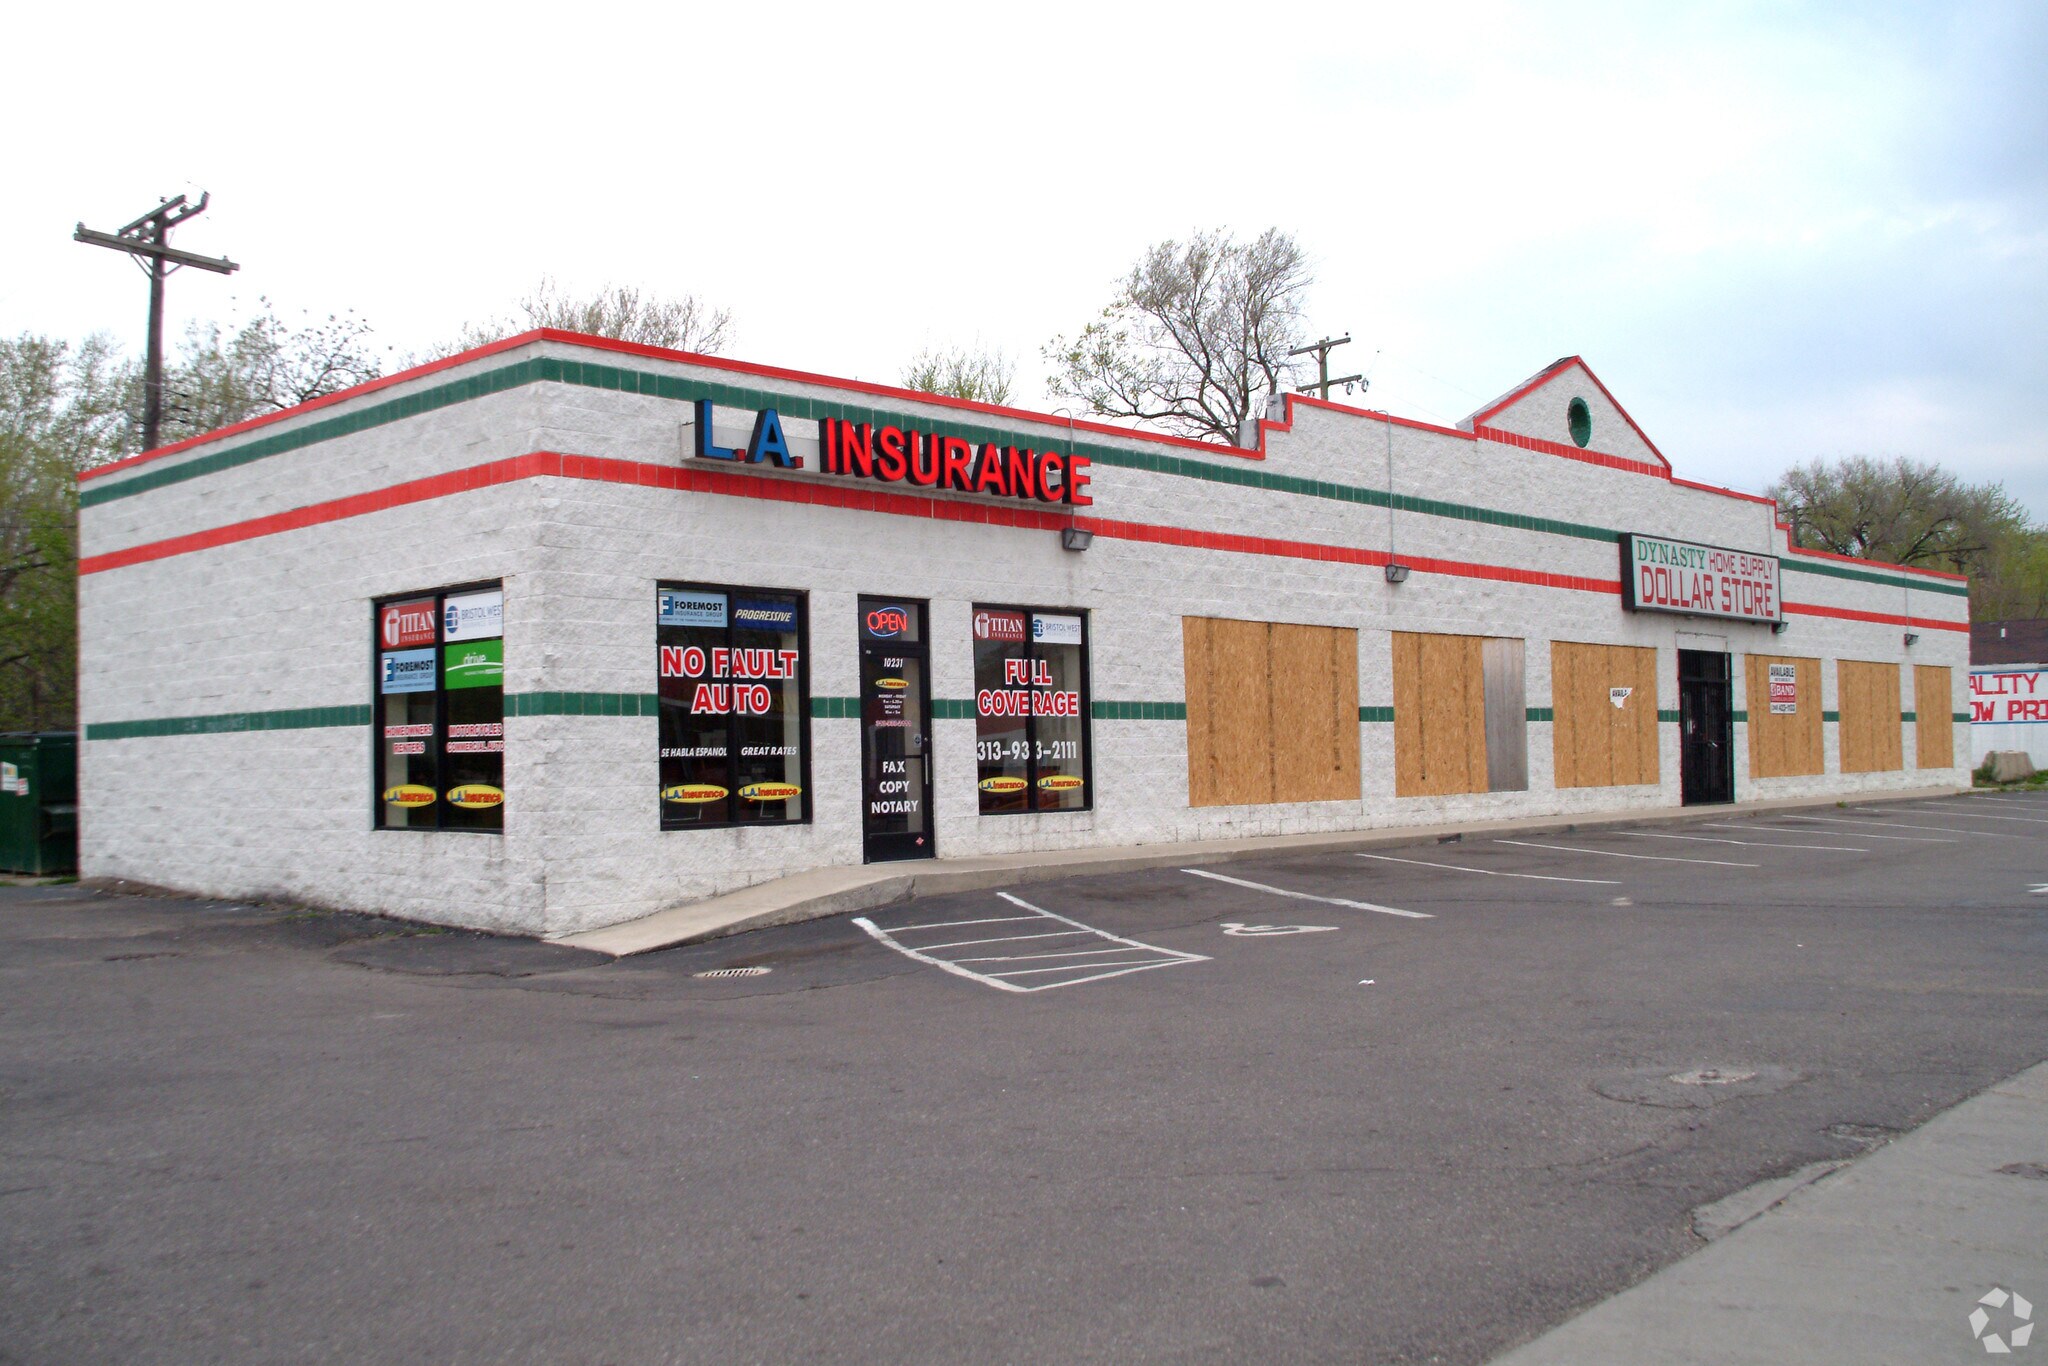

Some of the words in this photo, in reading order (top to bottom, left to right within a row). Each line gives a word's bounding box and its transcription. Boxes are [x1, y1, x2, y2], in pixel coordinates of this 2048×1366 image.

[695, 399, 803, 468] L.A.
[819, 416, 1093, 505] INSURANCE
[1637, 540, 1705, 569] DYNASTY
[1708, 551, 1736, 574] HOME
[1740, 555, 1773, 580] SUPPLY
[1641, 565, 1714, 610] DOLLAR
[1721, 576, 1774, 617] STORE
[675, 601, 722, 611] FOREMOST
[401, 610, 435, 633] TITAN
[735, 609, 792, 622] PROGRESSIVE
[867, 611, 907, 632] OPEN
[991, 617, 1023, 633] TITAN
[1045, 622, 1066, 632] BRISTOL
[1067, 624, 1080, 632] WEST
[396, 660, 434, 672] FOREMOST
[661, 646, 706, 678] NO
[712, 647, 799, 679] FAULT
[883, 658, 904, 668] 10231
[1005, 658, 1053, 686] FULL
[1770, 666, 1794, 677] AVAILABLE
[690, 683, 771, 714] AUTO
[978, 689, 1080, 717] COVERAGE
[448, 723, 503, 737] MOTORCYCLES
[393, 741, 425, 754] RENTERS
[661, 747, 670, 757] SE
[670, 747, 694, 757] HABLA
[695, 747, 728, 757] ESPANOL
[741, 746, 769, 756] GREAT
[770, 746, 797, 756] RATES
[977, 741, 1077, 760] 313-933-2111
[882, 761, 905, 773] FAX
[879, 780, 910, 793] COPY
[871, 800, 919, 813] NOTARY
